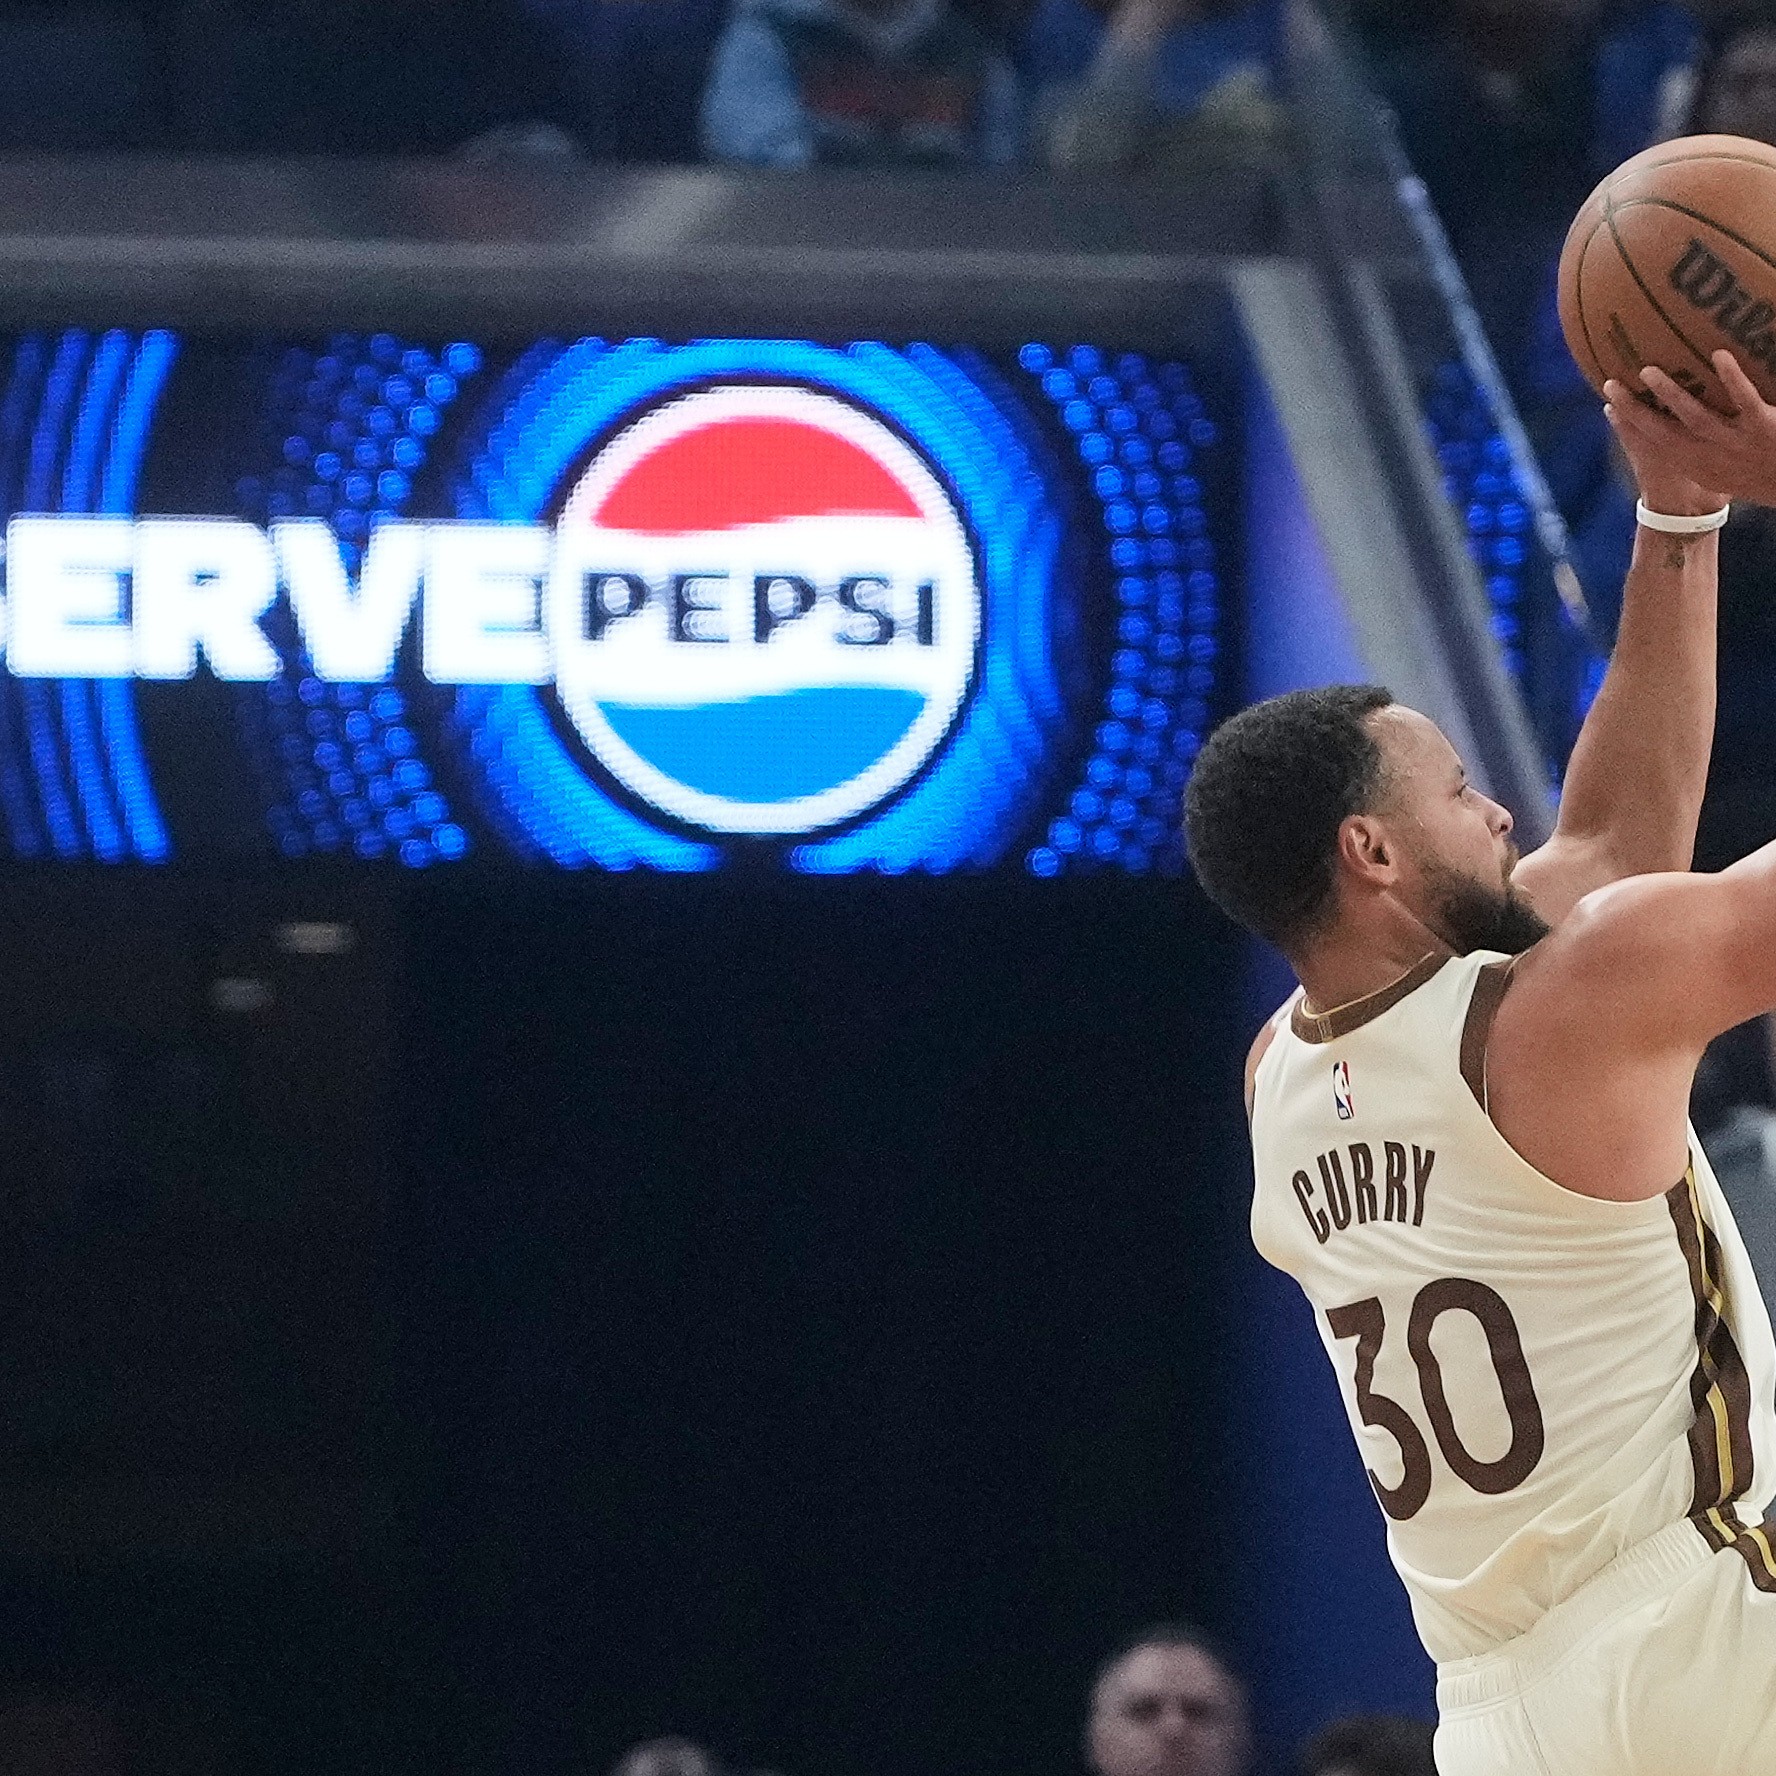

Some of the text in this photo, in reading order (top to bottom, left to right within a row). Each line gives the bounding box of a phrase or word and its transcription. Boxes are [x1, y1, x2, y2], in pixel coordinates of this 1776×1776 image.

[0, 513, 558, 685] ERVE
[579, 571, 938, 647] PEPSI
[1292, 1139, 1435, 1245] CURRY
[1326, 1277, 1545, 1522] 30
